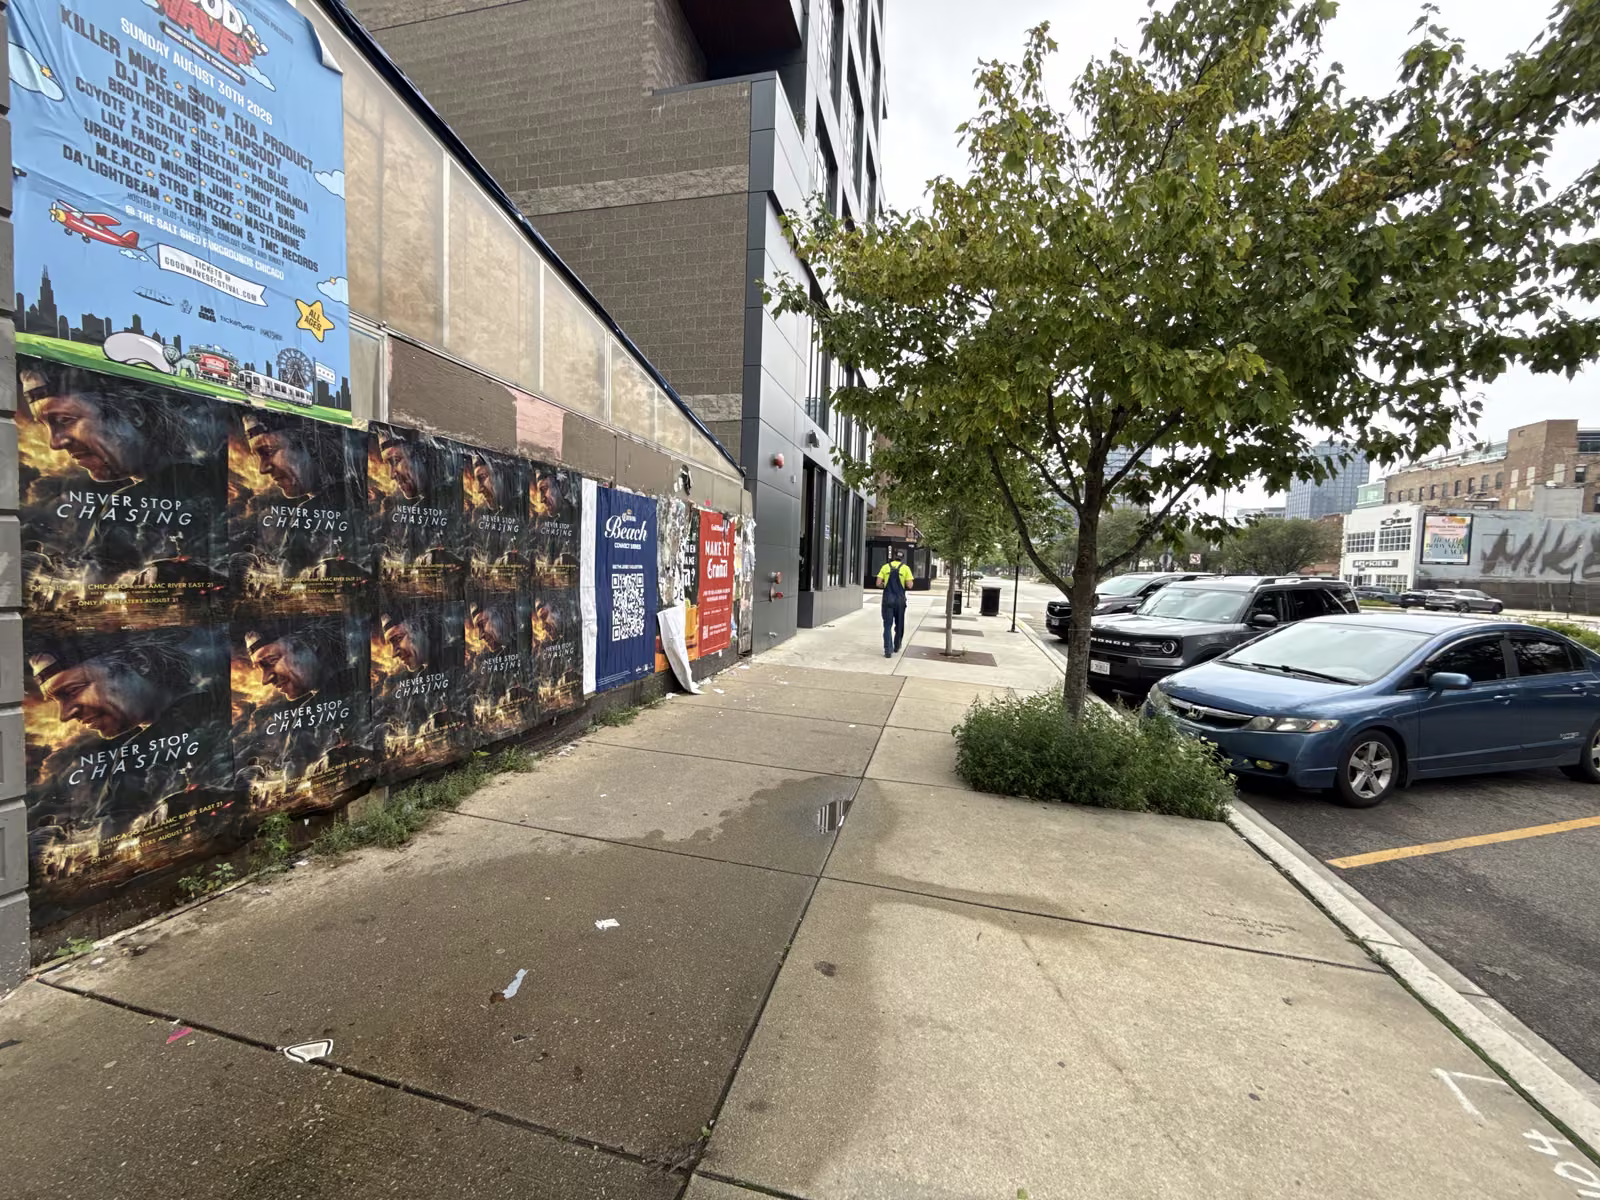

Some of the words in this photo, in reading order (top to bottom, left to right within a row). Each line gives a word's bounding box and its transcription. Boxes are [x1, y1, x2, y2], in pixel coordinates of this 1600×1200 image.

[121, 17, 170, 58] SUNDAY
[173, 51, 216, 88] AUGUST
[217, 80, 245, 108] 30TH
[247, 99, 272, 125] 2026
[61, 4, 120, 58] KILLER
[128, 47, 167, 86] MIKE
[188, 84, 226, 120] SNOW
[232, 112, 258, 140] THA
[263, 130, 313, 174] PRODUCT
[115, 59, 138, 87] DJ
[145, 77, 206, 127] PREMIER
[225, 125, 282, 170] RAPSODY
[108, 76, 164, 119] BROTHER
[169, 111, 187, 132] ALI
[200, 128, 226, 153] DEE-1
[238, 150, 263, 175] NAVY
[268, 167, 288, 189] BLUE
[76, 76, 126, 115] COYOTE
[132, 106, 141, 124] X
[146, 115, 187, 148] STATIK
[191, 139, 239, 177] SELEKTAH
[251, 173, 309, 214] PROPAGANDA
[84, 117, 156, 165] URBANIZED
[161, 156, 197, 186] MUSIC
[208, 182, 235, 205] JUNE
[246, 200, 275, 225] BELLA
[101, 107, 125, 133] LILY
[132, 124, 170, 155] FANGZ
[185, 152, 232, 188] RECOECHI
[244, 184, 271, 208] PINOY
[275, 200, 296, 220] RING
[63, 144, 160, 201] DA'LIGHTBEAM
[174, 197, 208, 223] STEPH
[211, 214, 244, 239] SIMON
[246, 231, 256, 245] &
[260, 237, 279, 255] TMC
[281, 248, 319, 273] RECORDS
[193, 189, 233, 219] BARZZZ
[244, 214, 301, 251] MASTERMINE
[137, 209, 155, 226] THE
[156, 217, 178, 236] SALT
[179, 228, 202, 246] SHED
[194, 259, 224, 280] TICKETS
[303, 315, 323, 332] AGES
[308, 308, 322, 322] ALL
[69, 490, 132, 507] NEVER
[140, 497, 182, 511] STOP
[397, 505, 421, 516] NEVER
[423, 507, 444, 516] STOP
[56, 503, 193, 526] CHASING
[262, 515, 348, 532] CHASING
[271, 505, 309, 518] NEVER
[313, 508, 342, 520] STOP
[392, 513, 448, 527] CHASING
[479, 521, 520, 534] CHASING
[541, 527, 573, 538] CHASING
[604, 514, 648, 541] Beach
[705, 540, 722, 556] MAKE
[395, 679, 449, 699] CHASING
[399, 677, 423, 689] NEVER
[426, 672, 444, 683] STOP
[266, 708, 350, 736] CHASING
[274, 706, 312, 722] NEVER
[316, 700, 343, 713] STOP
[81, 744, 140, 767] NEVER
[149, 732, 190, 752] STOP
[68, 742, 200, 786] CHASING
